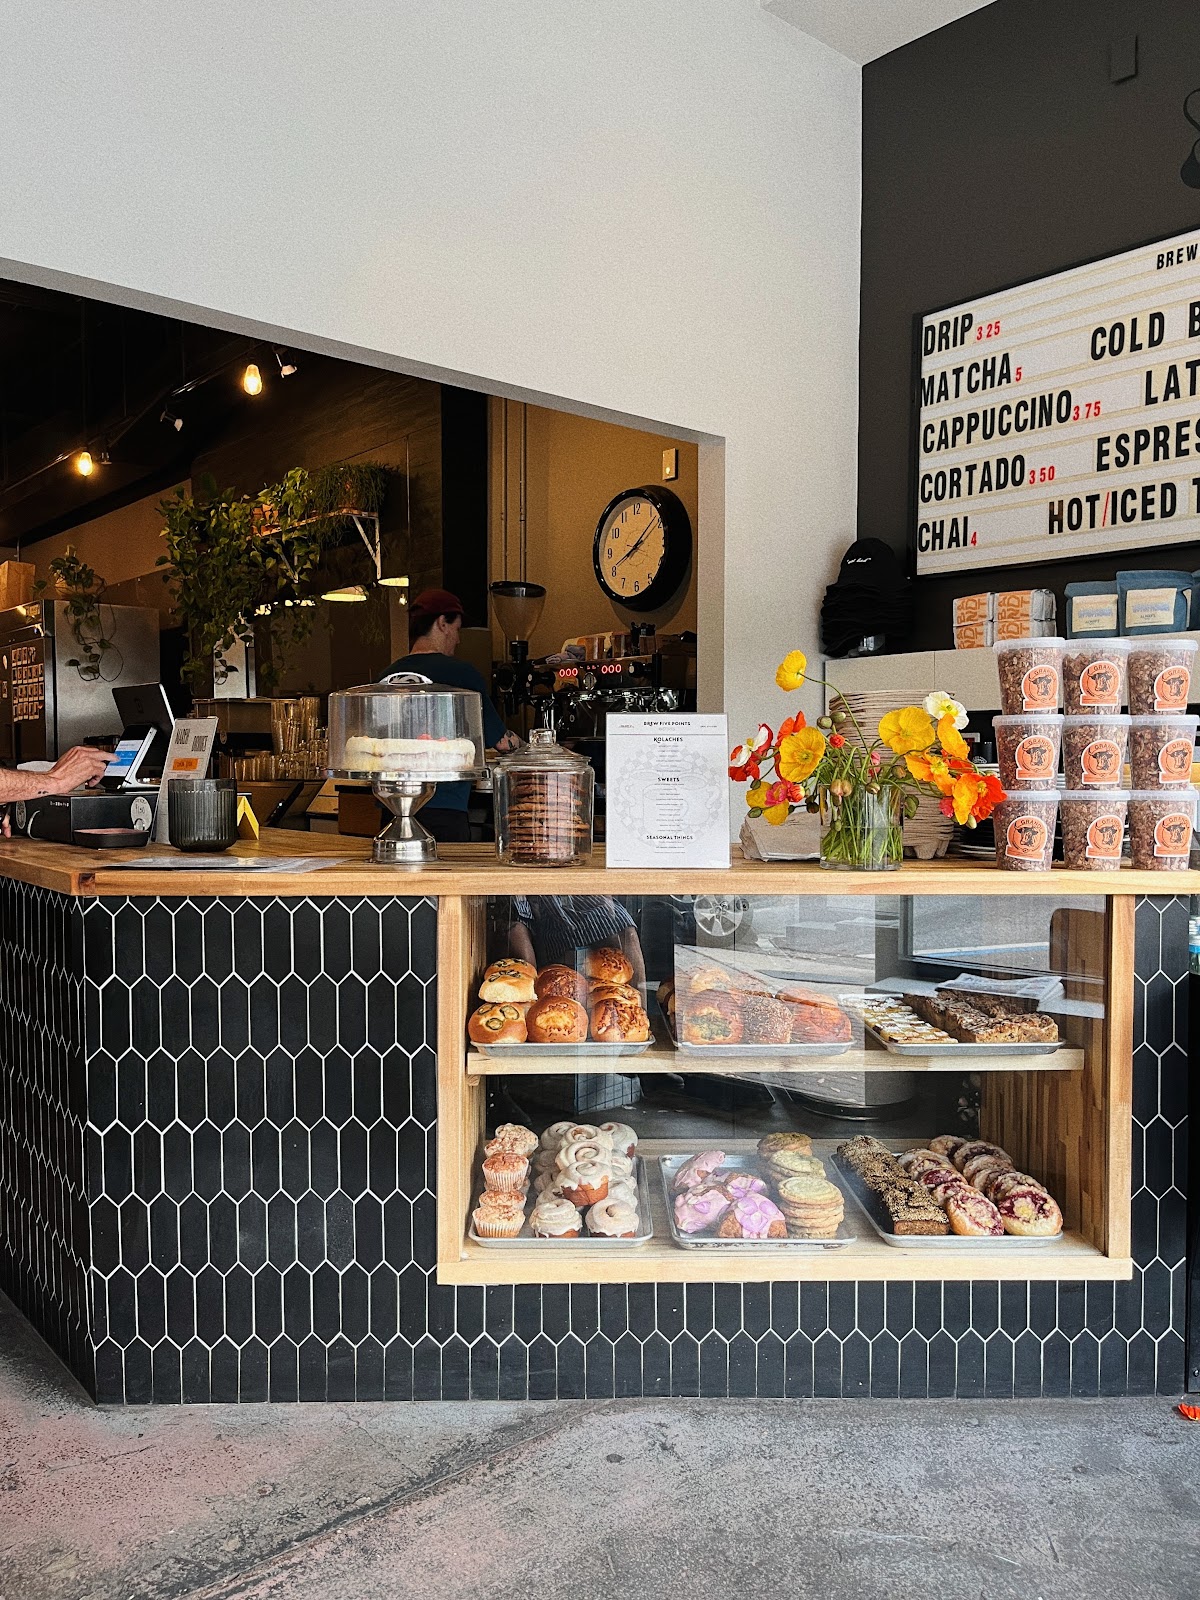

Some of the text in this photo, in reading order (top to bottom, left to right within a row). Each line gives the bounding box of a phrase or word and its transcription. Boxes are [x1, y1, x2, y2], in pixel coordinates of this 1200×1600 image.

[1157, 243, 1199, 270] BREW
[923, 312, 974, 357] DRIP
[1090, 311, 1165, 361] COLD
[920, 352, 1022, 408] MATCHA 5
[1145, 358, 1200, 407] LAT
[922, 389, 1072, 454] CAPPUCCINO
[920, 454, 1026, 504] CORTADO
[621, 511, 628, 523] 11
[633, 502, 641, 515] 12
[1048, 481, 1177, 535] HOT/ICED
[612, 527, 620, 539] 10
[918, 516, 978, 553] CHAI 4
[607, 548, 613, 559] 9
[611, 565, 617, 577] 8
[621, 577, 626, 589] 7
[634, 580, 640, 592] 6
